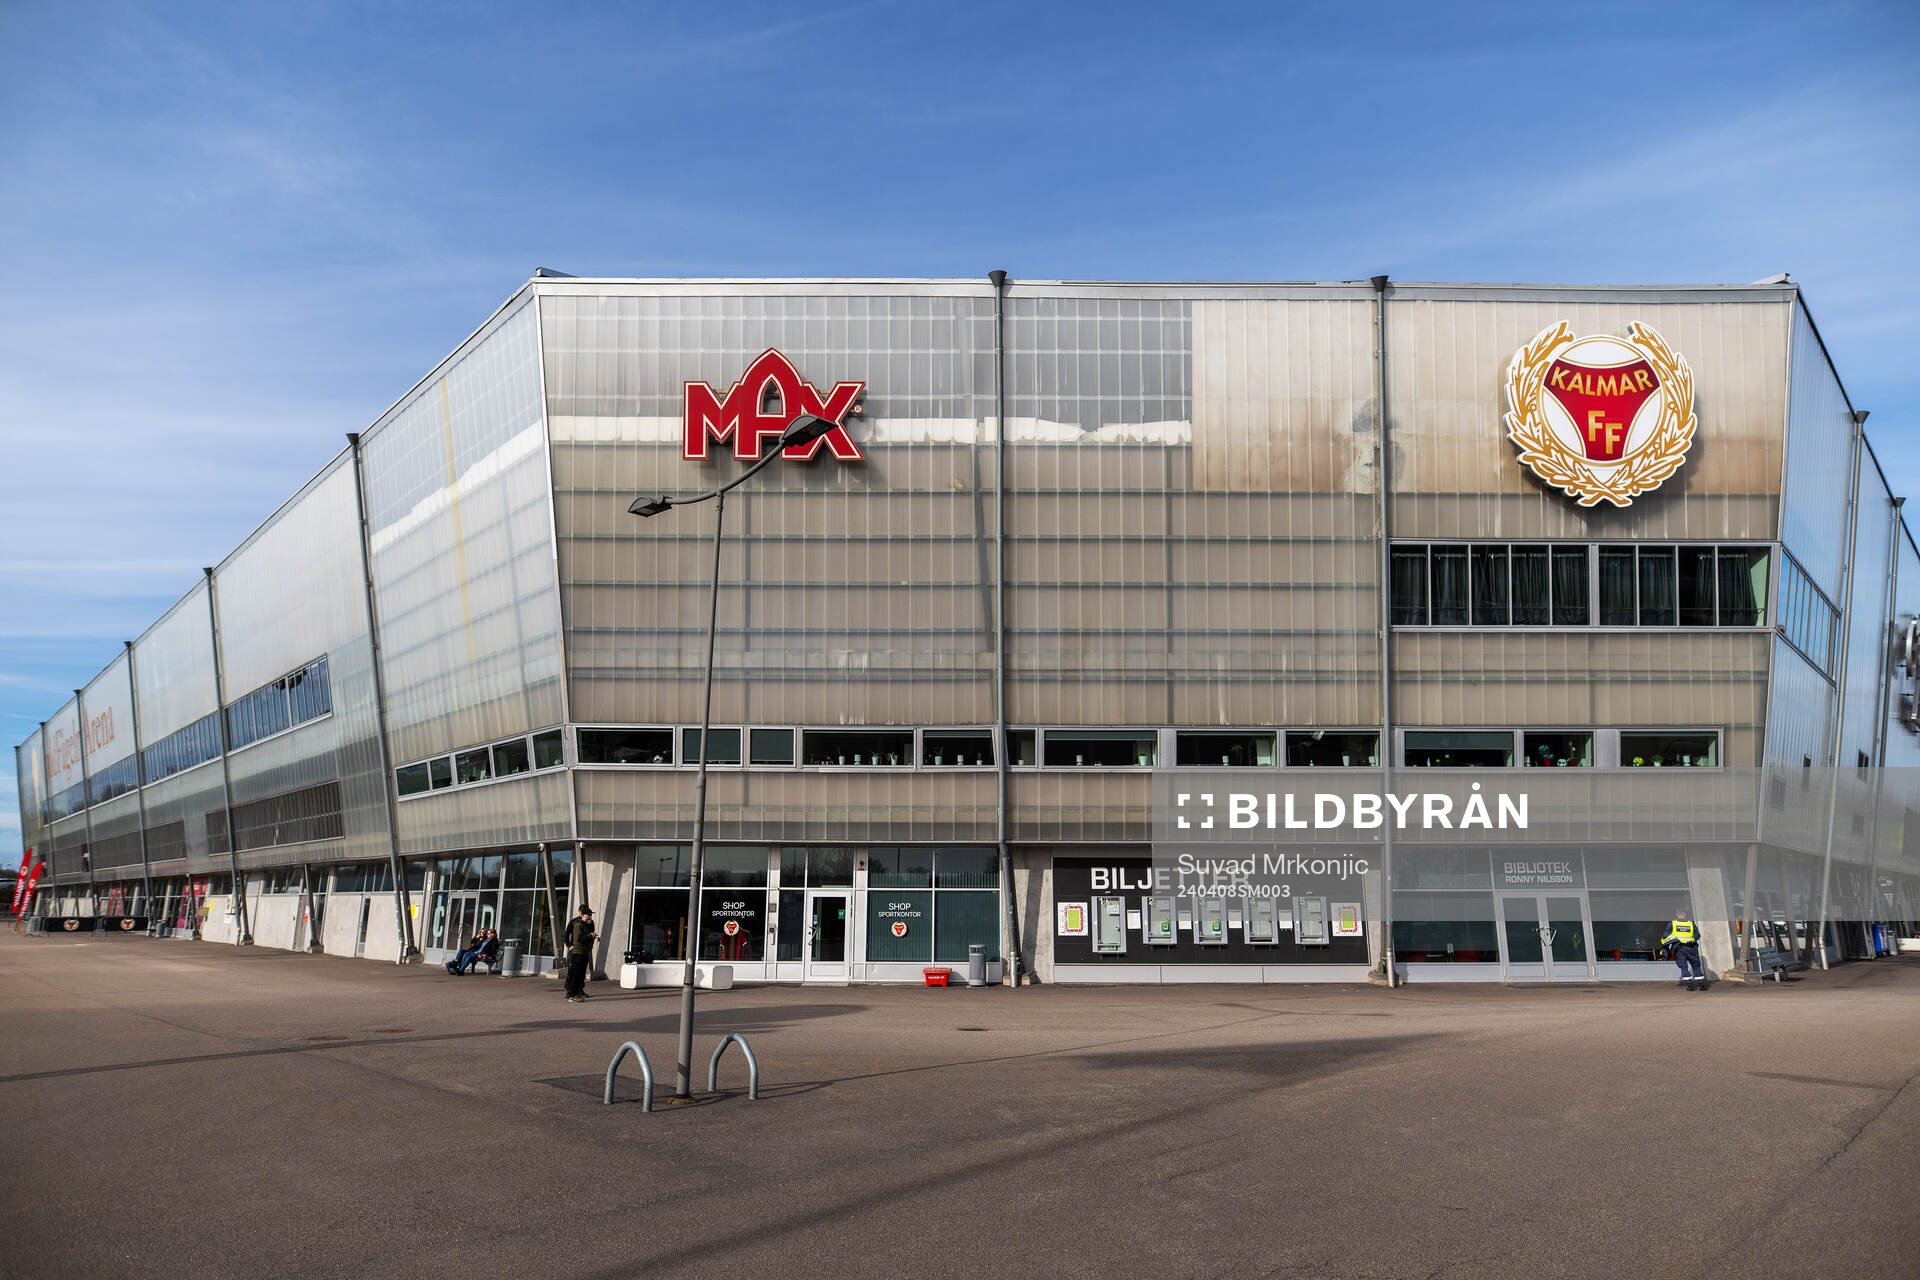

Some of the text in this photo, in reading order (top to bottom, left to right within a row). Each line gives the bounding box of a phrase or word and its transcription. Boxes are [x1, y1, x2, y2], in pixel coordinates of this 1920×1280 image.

[1550, 366, 1654, 397] KALMAR
[683, 347, 866, 461] MAX
[1587, 410, 1623, 455] FF
[1503, 862, 1572, 874] BIBLIOTEK
[1505, 875, 1573, 884] RONNY NILSSON
[722, 901, 745, 910] SHOP
[888, 902, 911, 911] SHOP
